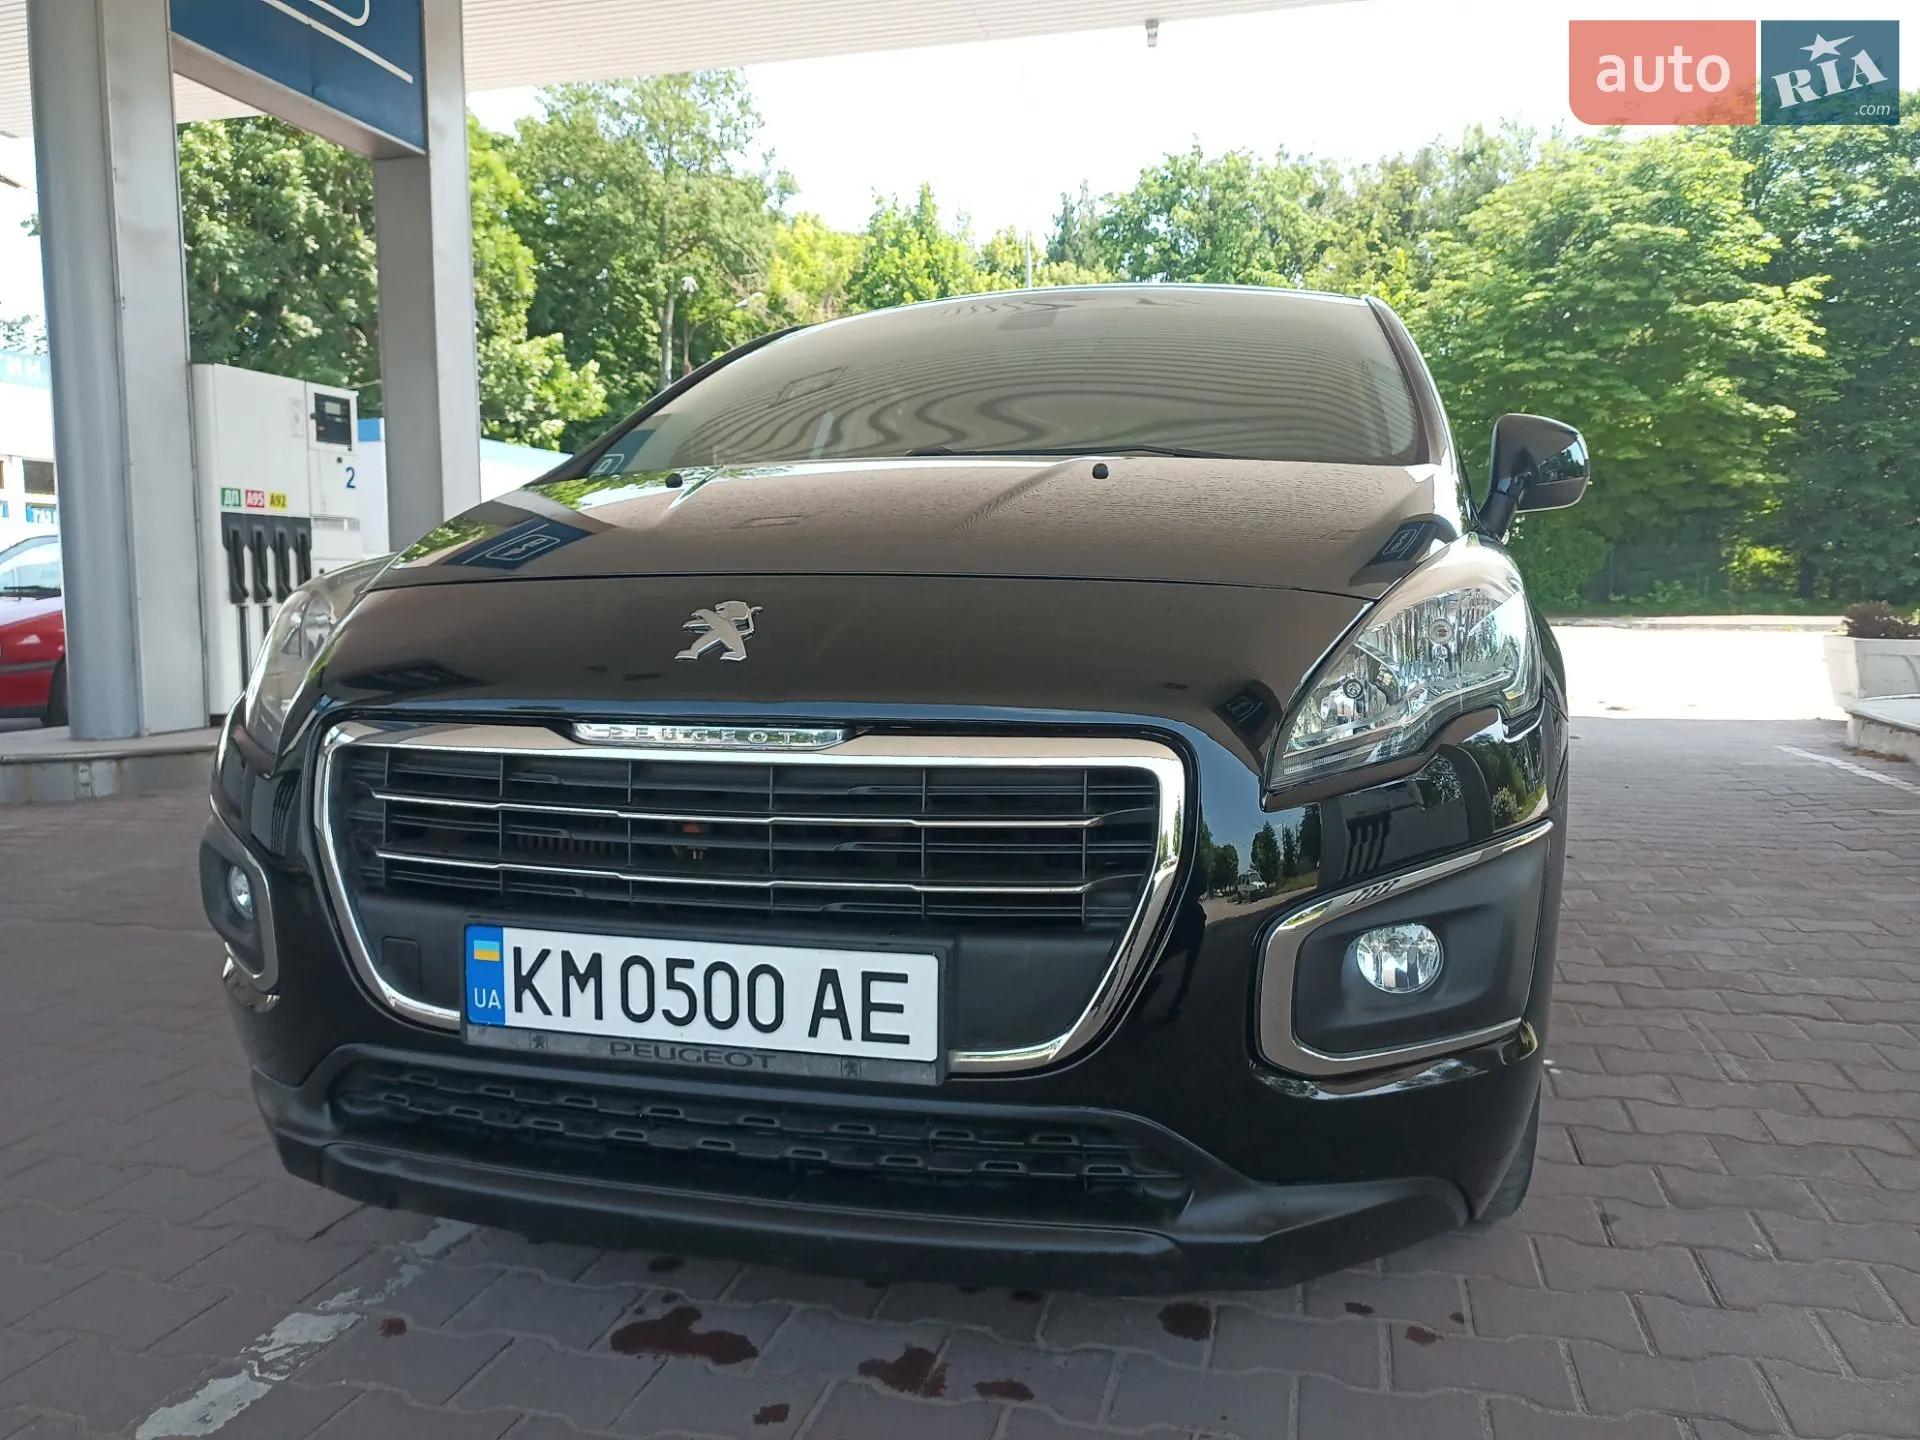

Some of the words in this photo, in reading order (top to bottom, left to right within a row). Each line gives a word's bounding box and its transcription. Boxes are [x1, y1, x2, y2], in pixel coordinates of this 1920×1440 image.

[346, 467, 356, 489] 2
[608, 726, 797, 744] PEUGEOT
[474, 987, 502, 1009] UA
[609, 1042, 777, 1070] PEUGEOT
